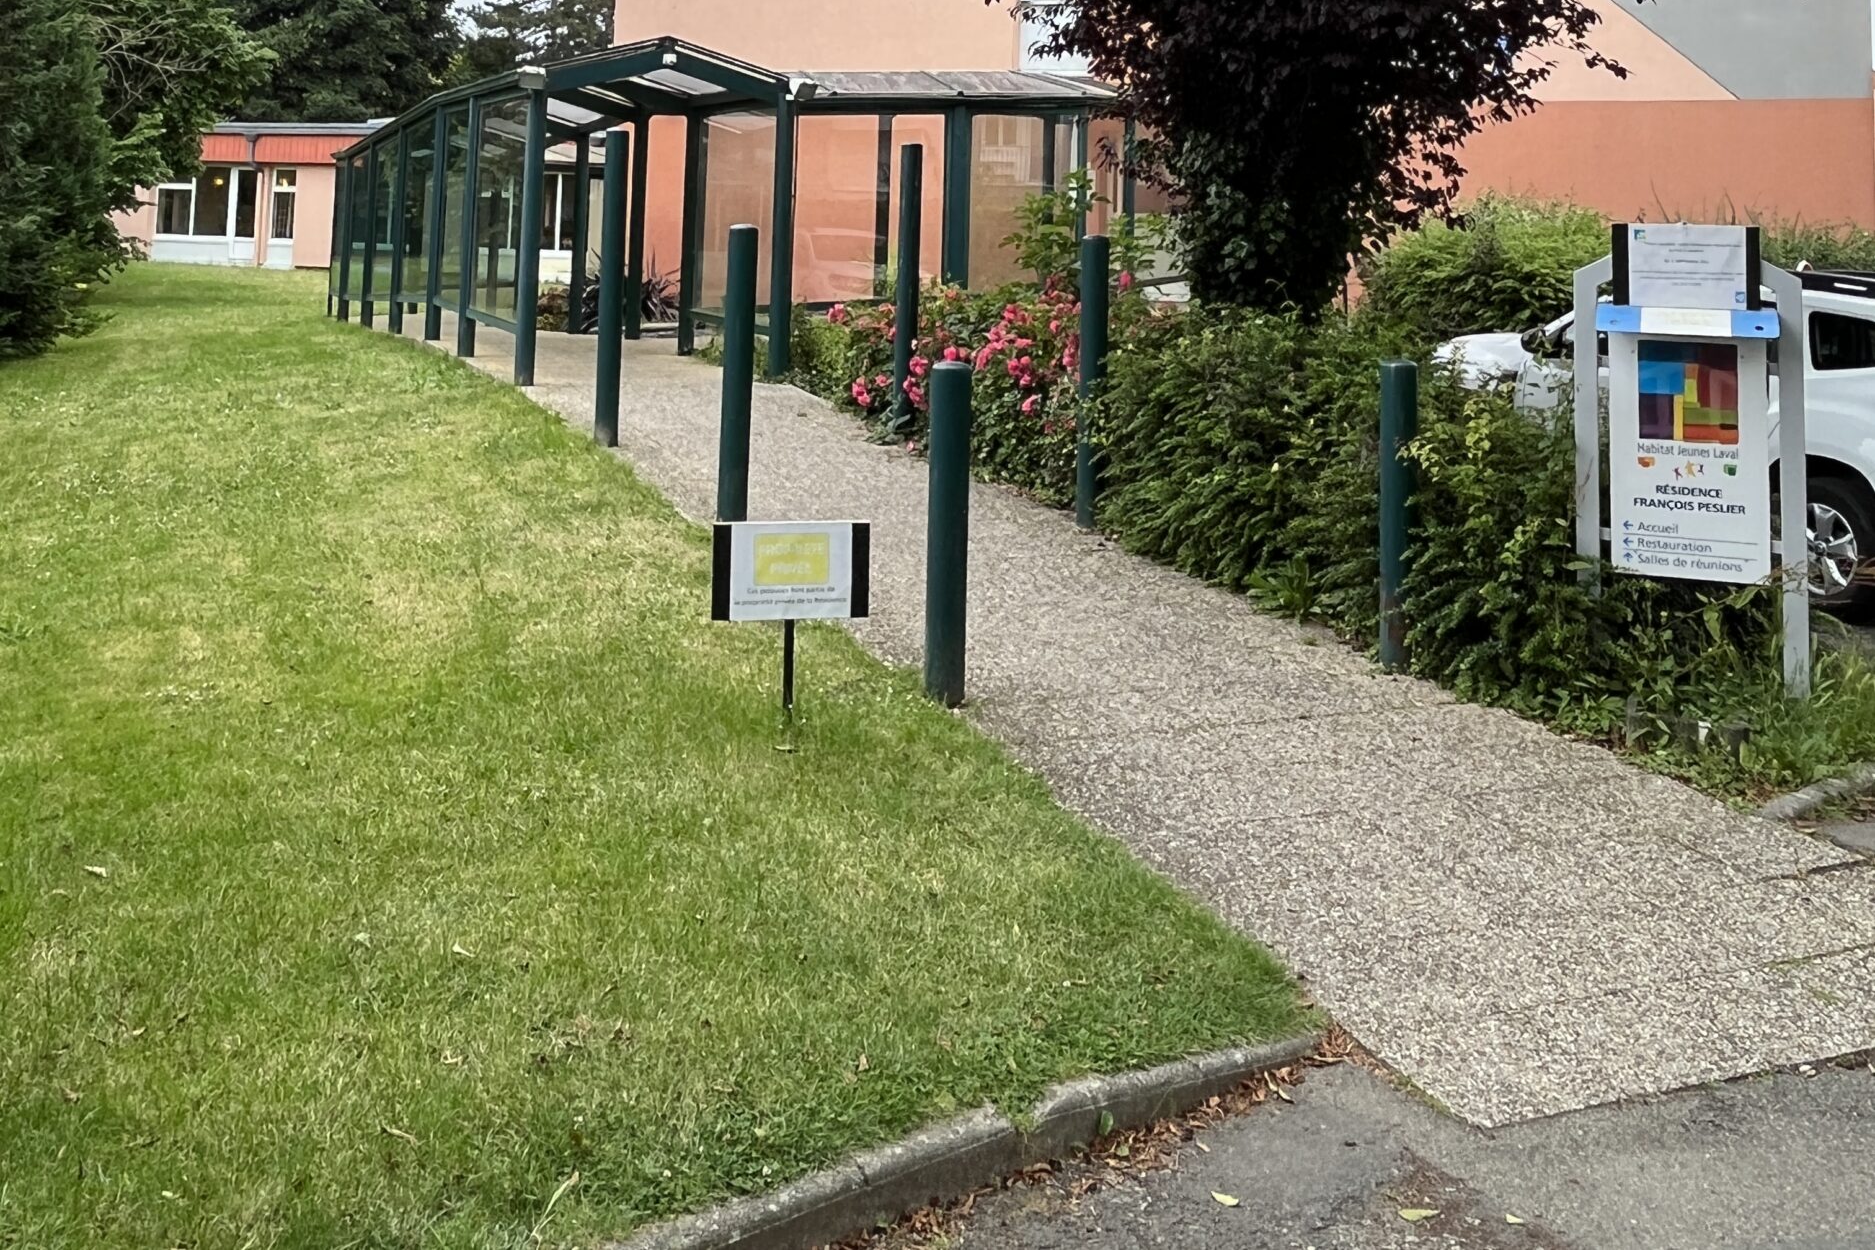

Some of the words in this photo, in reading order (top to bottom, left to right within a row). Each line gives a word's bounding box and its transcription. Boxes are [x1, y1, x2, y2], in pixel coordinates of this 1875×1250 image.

[1637, 442, 1674, 455] Habitat
[1677, 445, 1710, 458] Jeunes
[1713, 448, 1739, 459] Laval
[1655, 484, 1722, 499] RÉSIDENCE
[1633, 497, 1695, 511] FRANÇOIS
[1698, 502, 1746, 515] PESLIER
[1637, 521, 1679, 534] Accueil
[1637, 537, 1712, 553] Restauration
[1637, 553, 1669, 566] Salles
[1672, 557, 1688, 568] de
[1691, 559, 1743, 572] réunions
